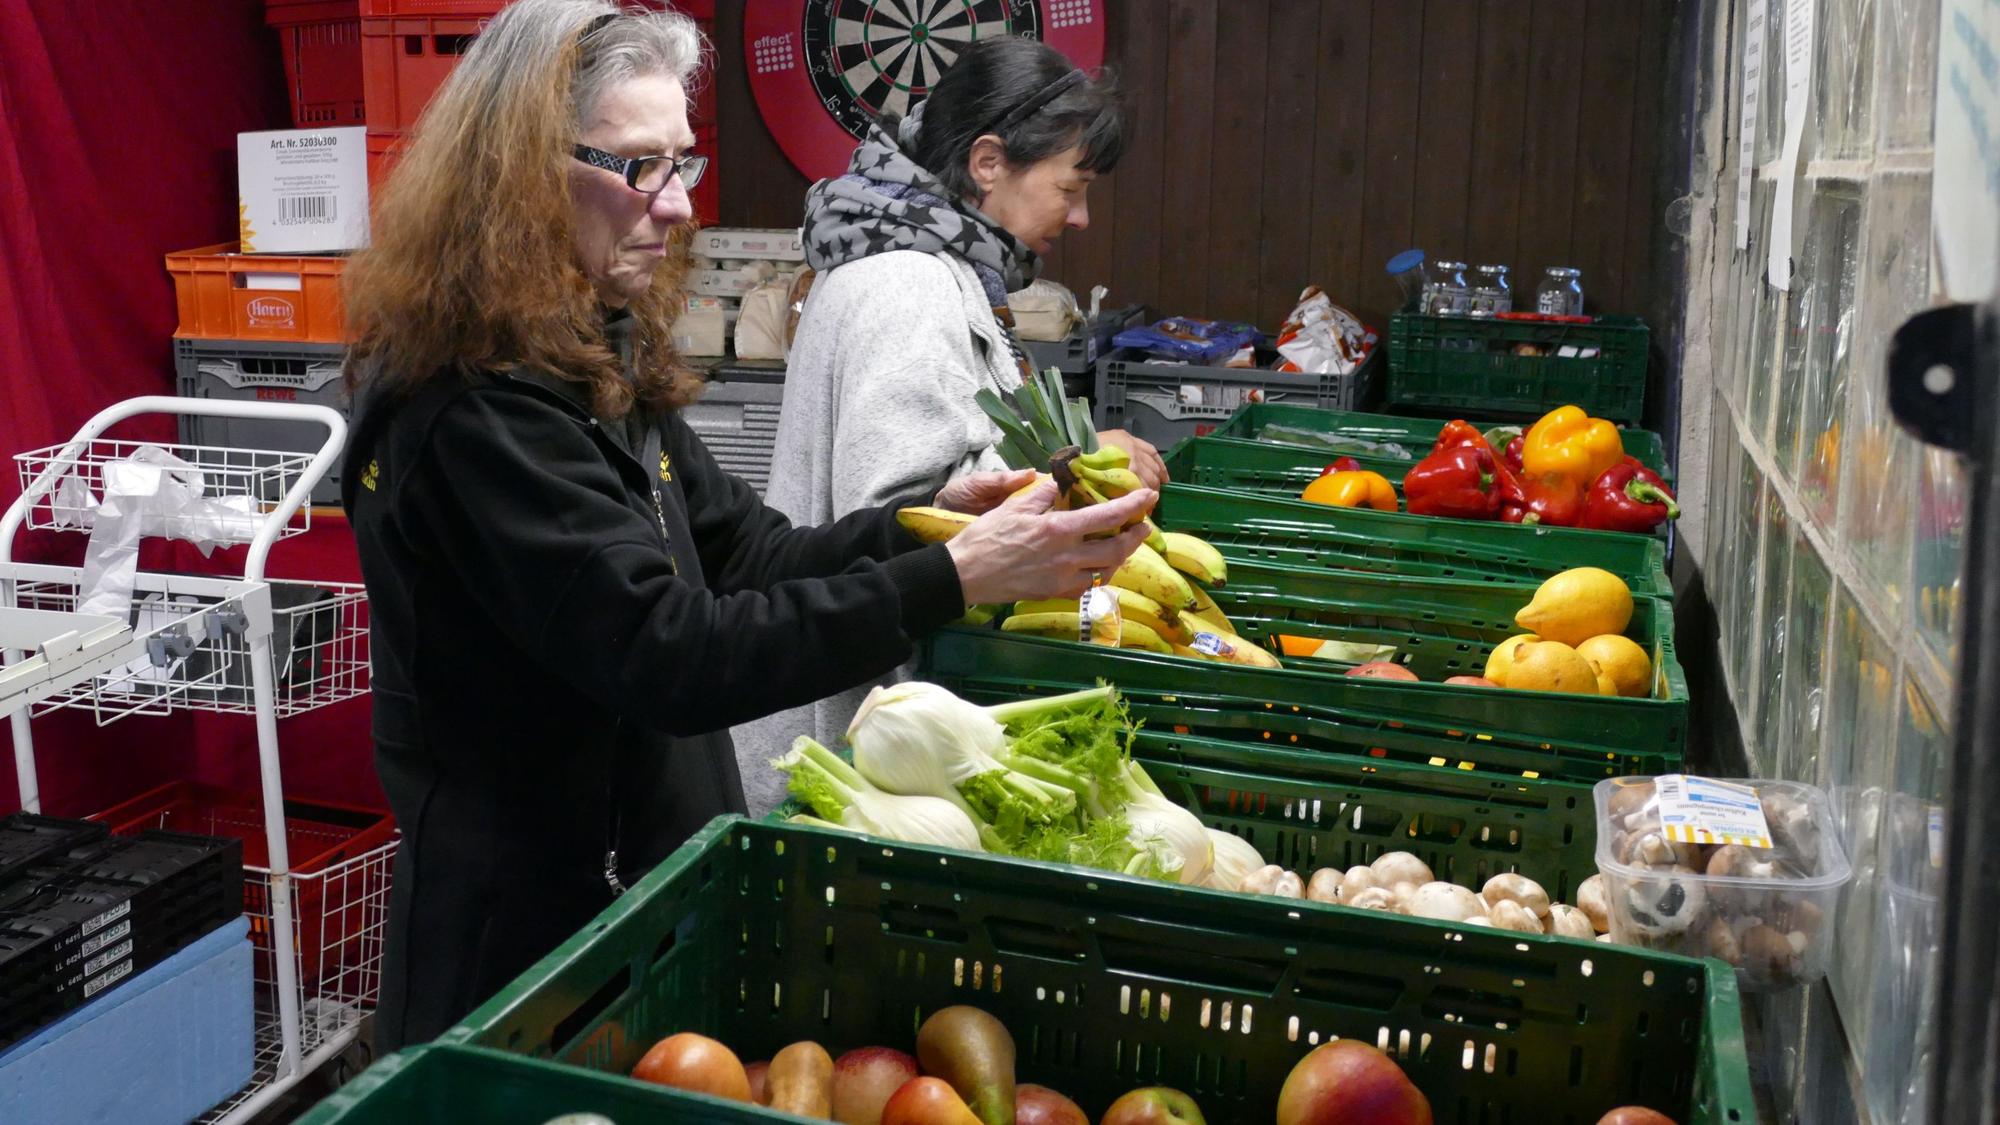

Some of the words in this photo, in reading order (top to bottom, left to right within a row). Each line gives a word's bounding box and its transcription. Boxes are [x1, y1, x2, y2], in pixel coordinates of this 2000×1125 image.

[754, 34, 791, 48] effect
[271, 140, 286, 149] Art.
[286, 139, 298, 148] Nr.
[256, 387, 297, 400] REWE
